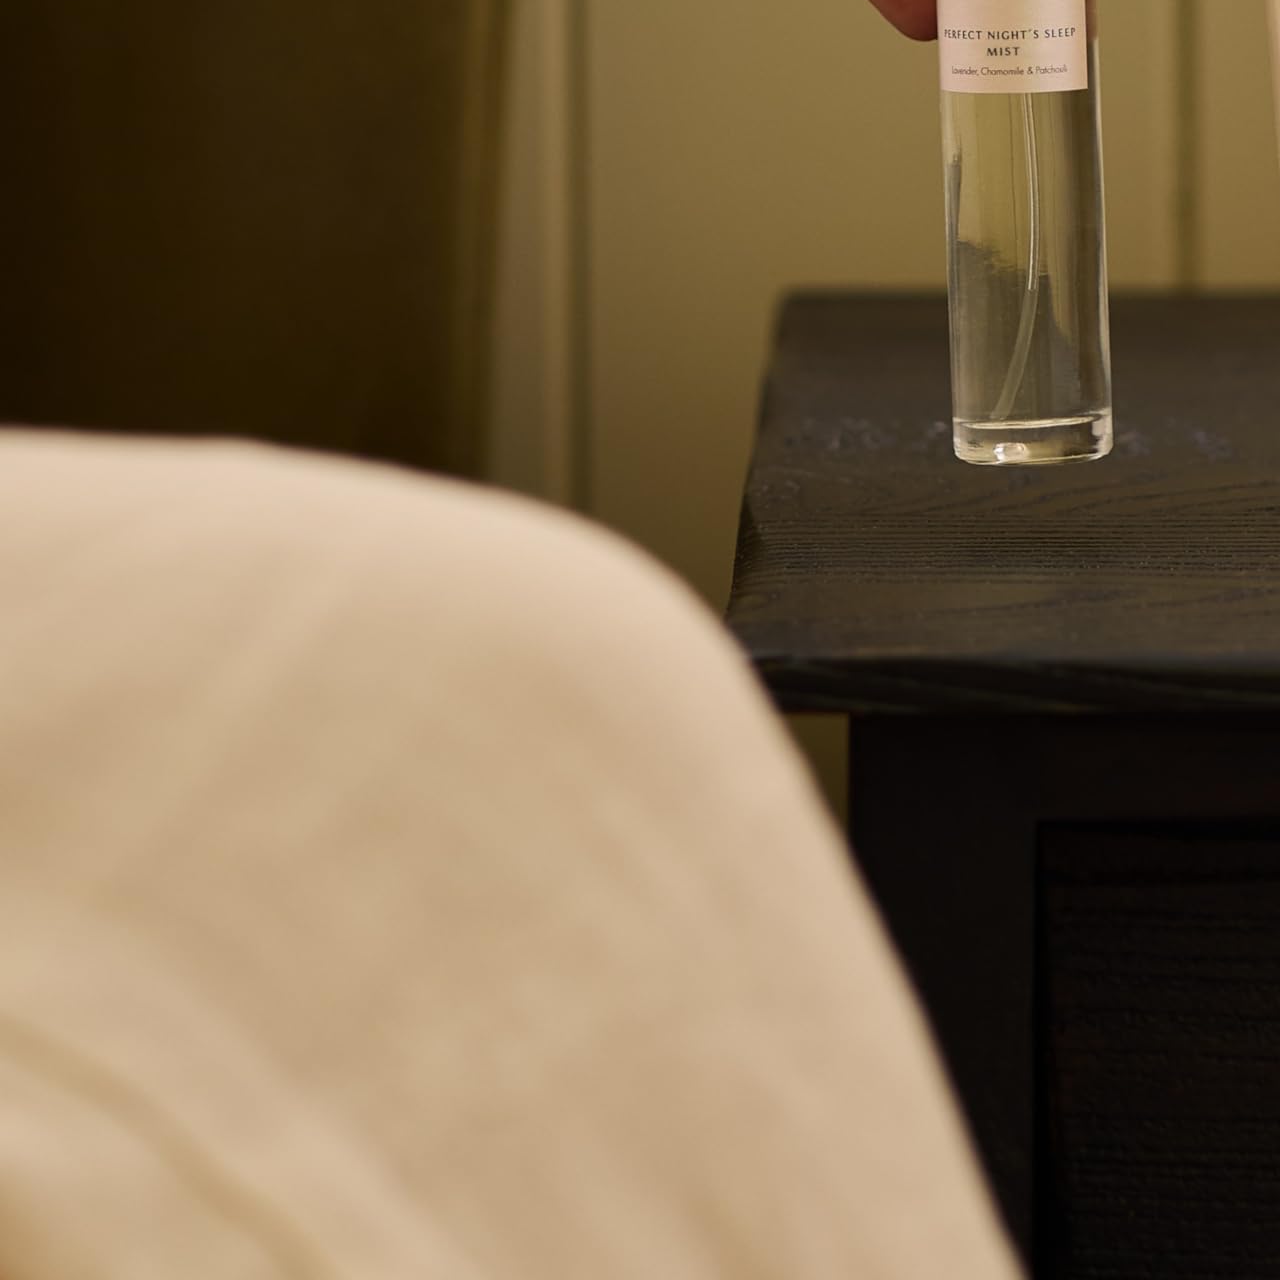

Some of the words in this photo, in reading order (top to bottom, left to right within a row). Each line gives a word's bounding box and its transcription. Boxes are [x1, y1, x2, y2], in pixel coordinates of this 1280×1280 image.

[944, 28, 983, 41] PERFECT
[987, 28, 1039, 41] NIGHT'S
[1044, 27, 1076, 39] SLEEP
[986, 46, 1021, 57] MIST
[980, 66, 1024, 76] Chamomile
[1026, 66, 1034, 75] &
[1035, 64, 1068, 75] Patchouli
